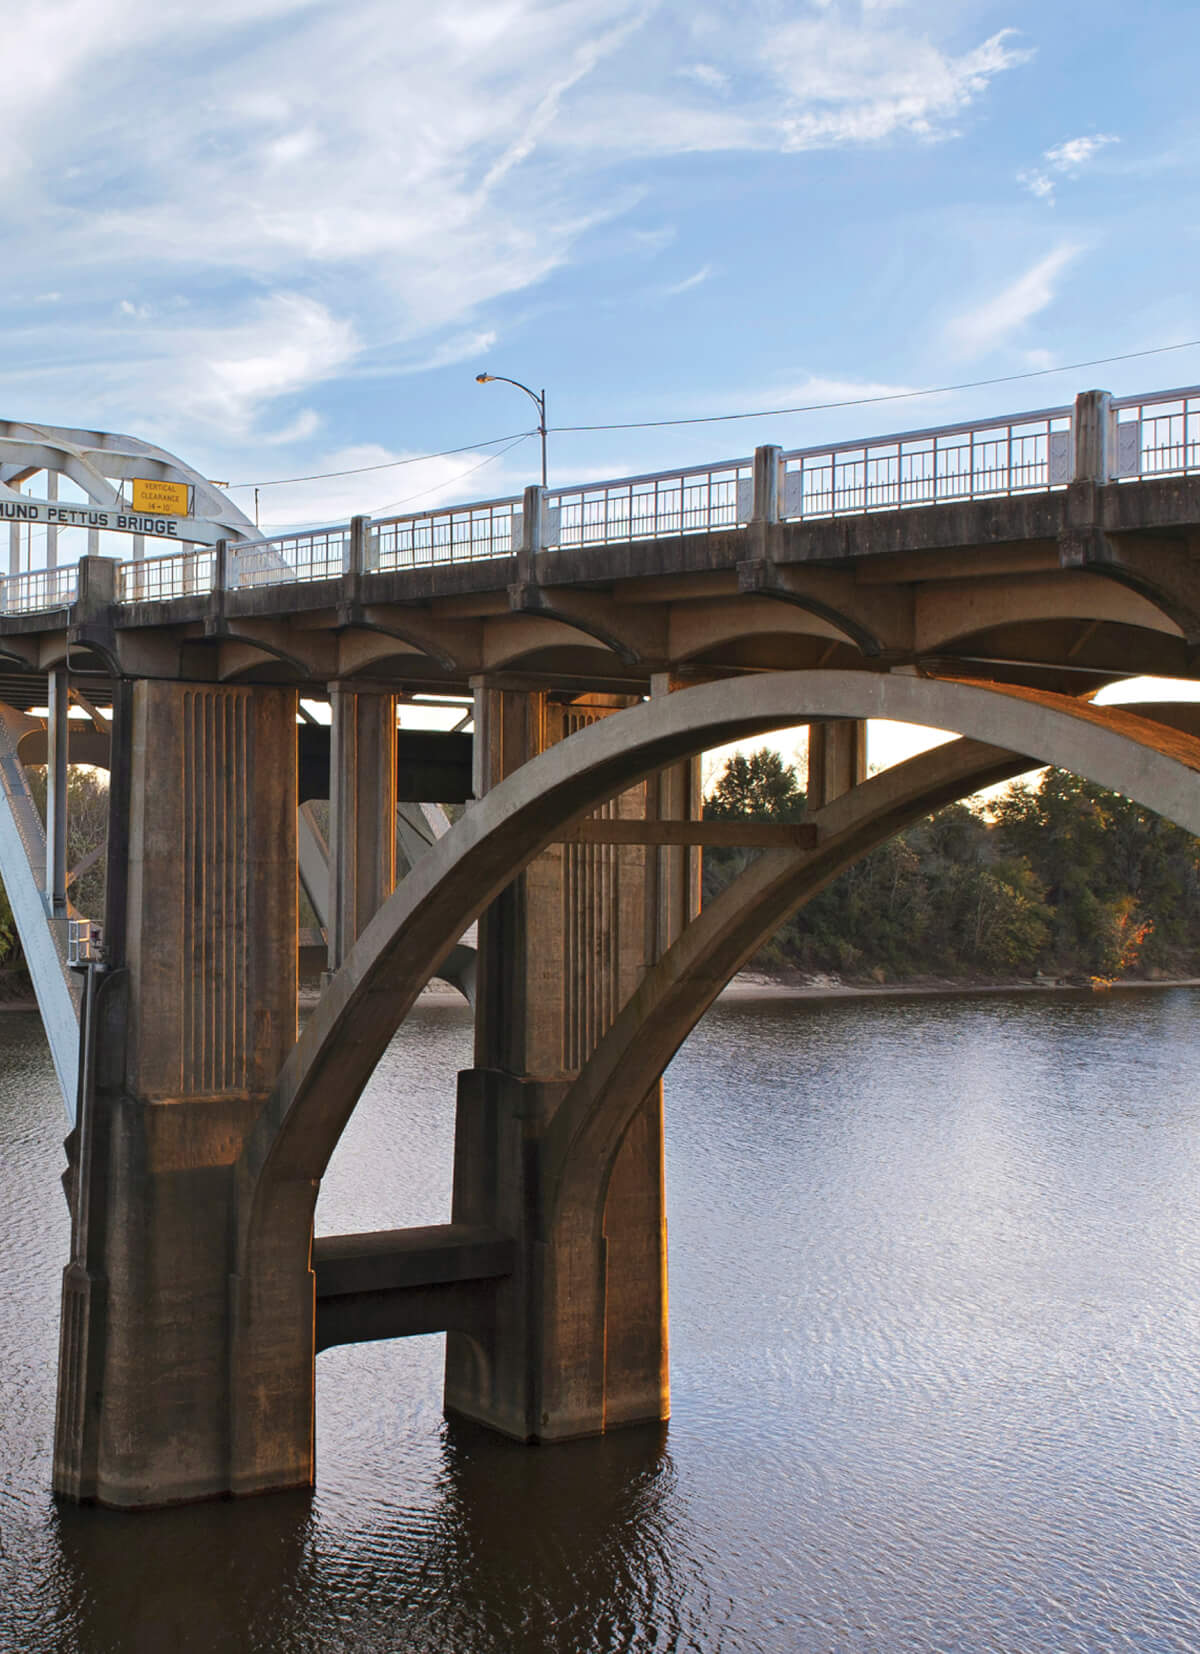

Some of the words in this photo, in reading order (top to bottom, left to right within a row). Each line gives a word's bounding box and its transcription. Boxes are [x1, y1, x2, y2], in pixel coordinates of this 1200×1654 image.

[145, 483, 176, 493] VERTICAL
[141, 491, 179, 502] CLEARANCE
[48, 508, 108, 526] PETTUS
[117, 515, 177, 535] BRIDGE
